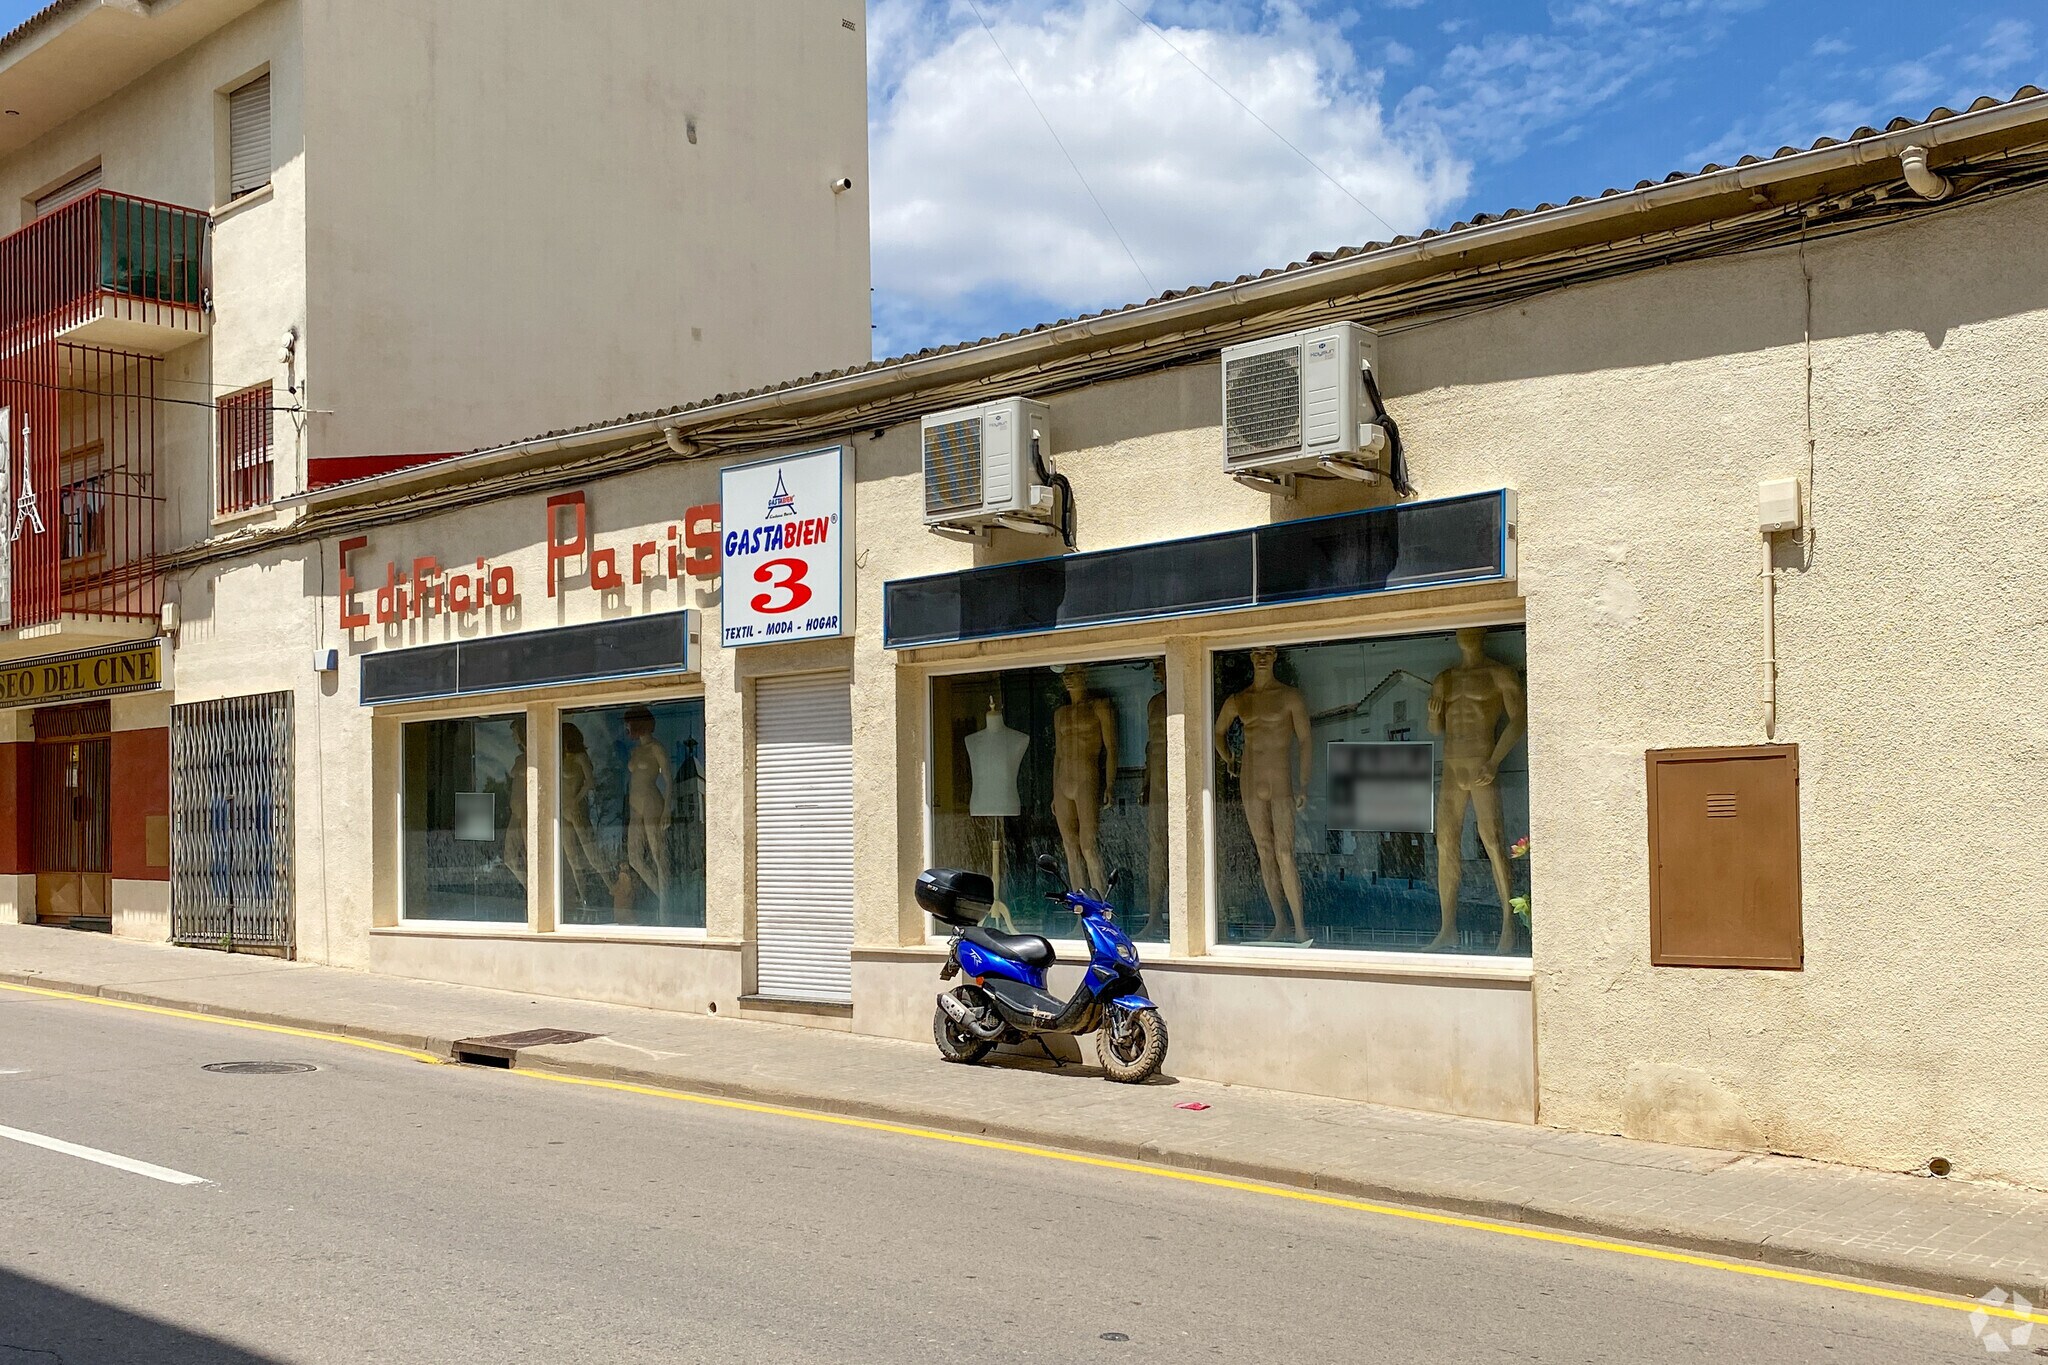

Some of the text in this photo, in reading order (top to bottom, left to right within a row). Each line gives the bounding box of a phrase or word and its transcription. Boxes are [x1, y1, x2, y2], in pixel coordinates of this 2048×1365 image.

[768, 495, 794, 506] GASTABIEN
[339, 535, 514, 630] Edificio
[750, 557, 813, 614] 3
[725, 625, 754, 640] TEXTIL
[766, 621, 793, 636] MODA
[805, 616, 838, 631] HOGAR
[43, 664, 85, 693] DEL
[94, 652, 154, 686] CINE
